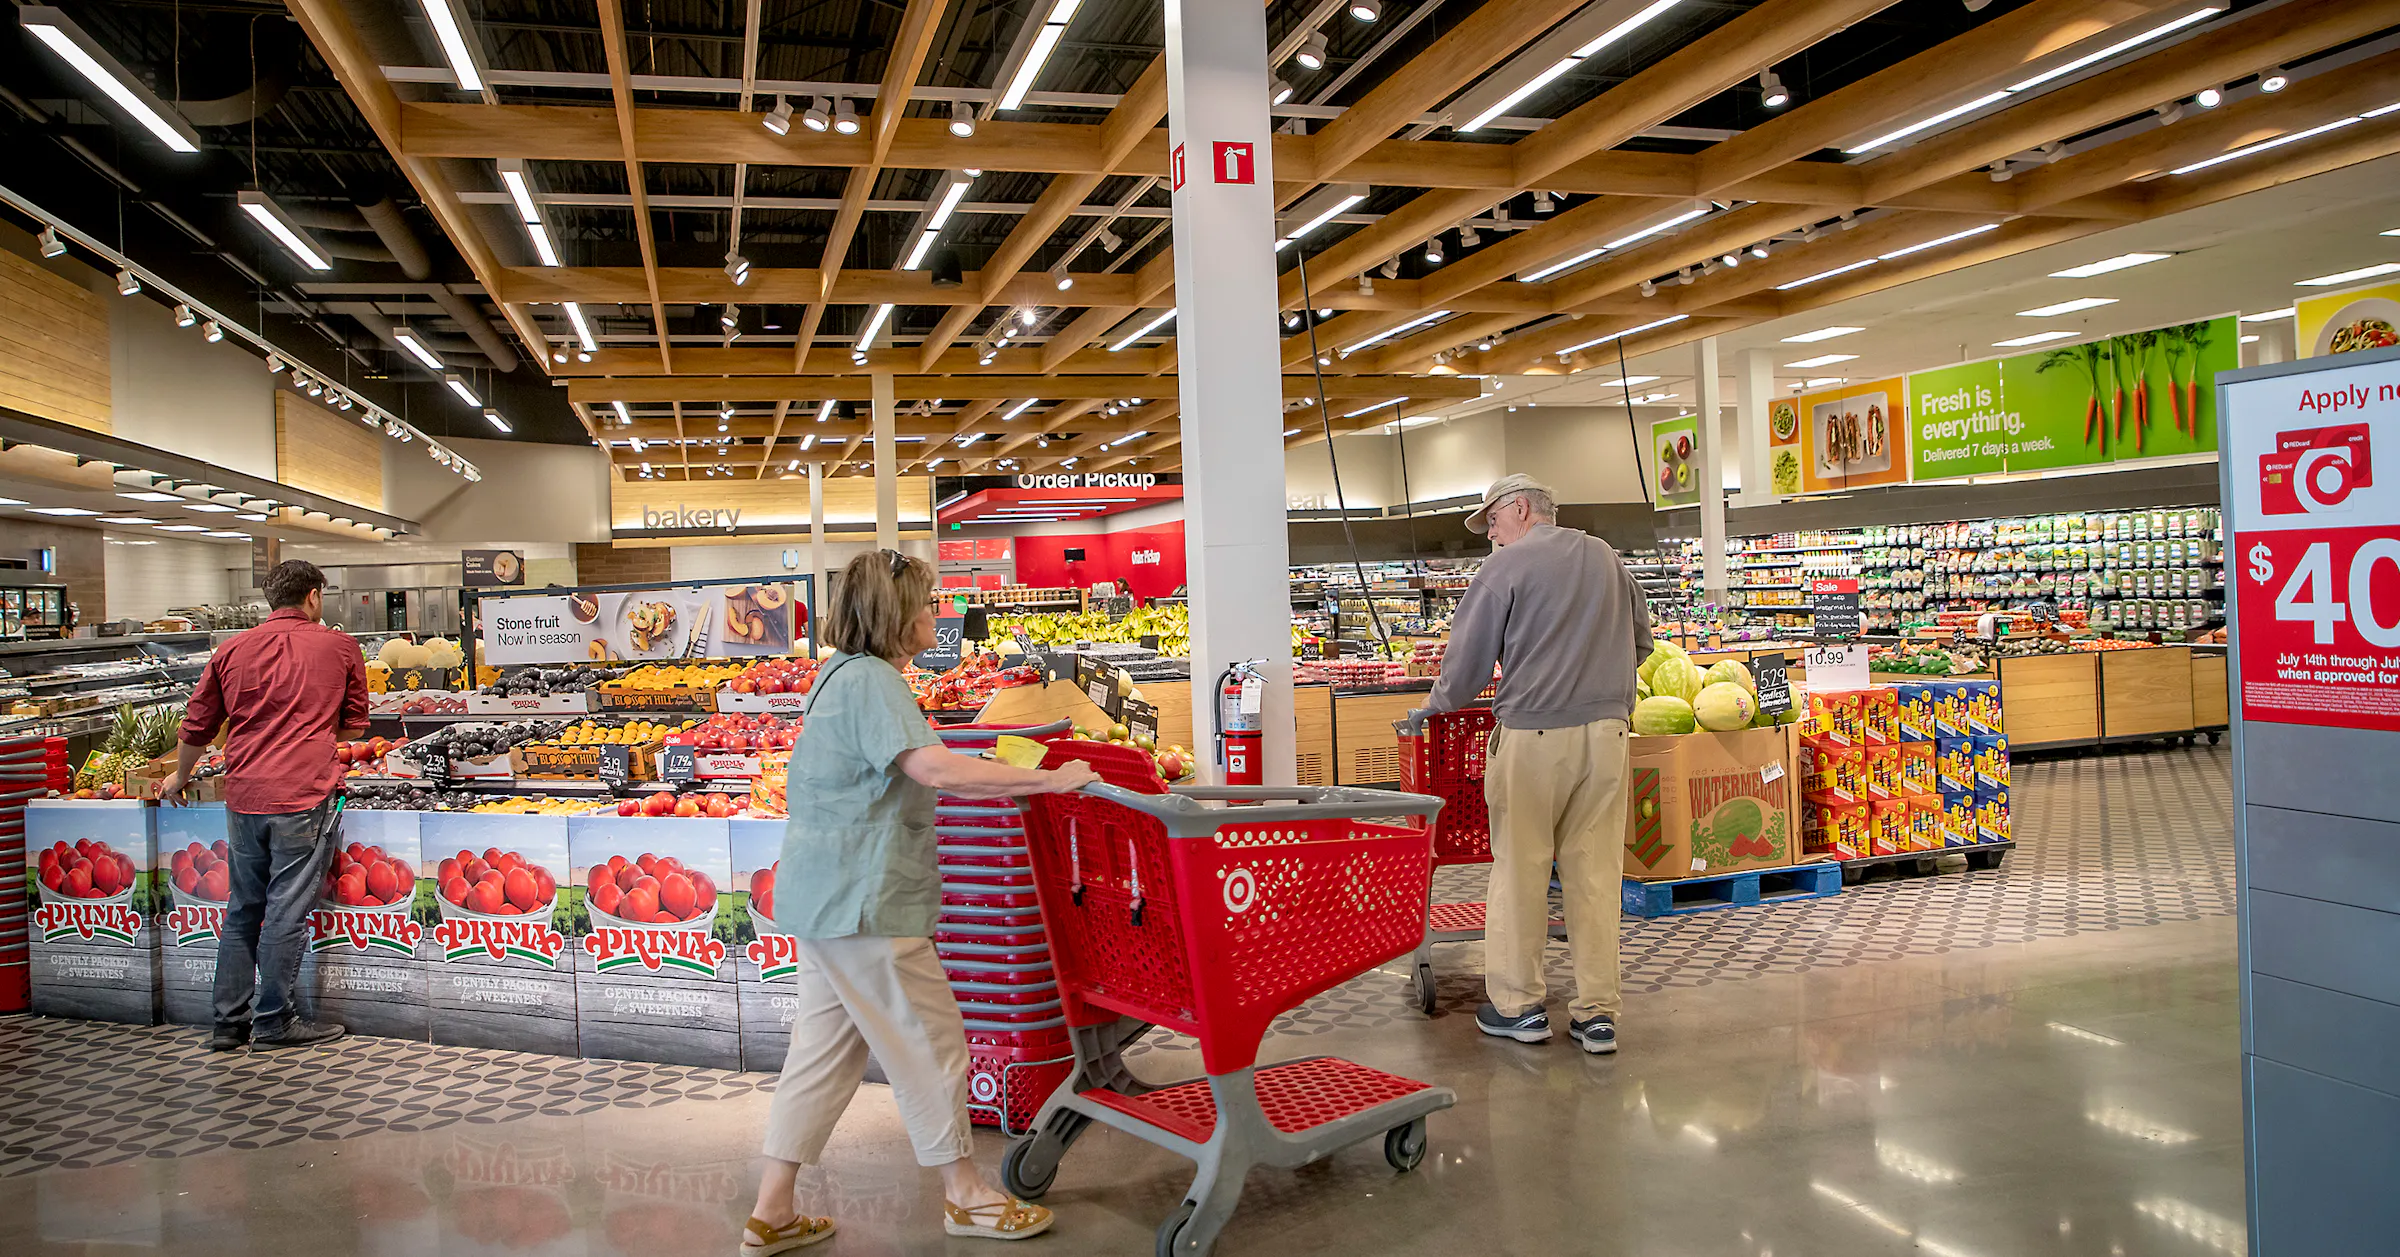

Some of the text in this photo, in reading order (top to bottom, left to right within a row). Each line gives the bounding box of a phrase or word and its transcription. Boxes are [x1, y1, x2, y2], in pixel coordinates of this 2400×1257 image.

[1922, 385, 1992, 416] Fresh is
[2298, 384, 2370, 414] Apply
[1922, 411, 2025, 440] everything.
[1923, 436, 2054, 462] Delivered 7 days a week.
[1018, 472, 1156, 490] Order Pickup
[1288, 493, 1327, 510] eat
[643, 504, 741, 532] bakery
[1816, 582, 1838, 592] Sale
[2249, 538, 2400, 648] $ 40
[497, 616, 560, 630] Stone fruit
[498, 632, 581, 646] Now in season
[1753, 658, 1760, 668] $
[1808, 652, 1844, 665] 10.99
[2277, 652, 2300, 667] July
[2303, 654, 2327, 666] 14th
[2330, 654, 2377, 670] through
[2278, 668, 2398, 684] when approved for
[614, 694, 674, 706] BLOSSOM HILL
[1758, 689, 1786, 701] Seedless
[512, 701, 540, 709] PRIMA
[768, 698, 800, 708] PRIMA
[666, 736, 680, 744] Sale
[540, 754, 599, 765] BLOSSOM HILL
[710, 759, 745, 769] PRIMA
[1691, 765, 1736, 776] red ripe
[1689, 772, 1784, 819] WATERMELON
[36, 904, 141, 940] PRIMA
[168, 906, 227, 940] PRI
[307, 912, 422, 949] PRIMA
[435, 919, 563, 959] PRIMA
[585, 928, 724, 970] PRIMA
[51, 955, 129, 968] GENTLY PACKED
[185, 959, 217, 970] GENT
[69, 968, 124, 980] SWEETNESS
[319, 966, 408, 980] GENTLY PACKED
[340, 979, 403, 992] SWEETNESS
[453, 976, 549, 992] GENTLY PACKED
[476, 991, 542, 1005] SWEETNESS
[605, 988, 709, 1004] GENTLY PACKED
[770, 996, 799, 1009] GEN
[630, 1003, 702, 1017] SWEETNESS
